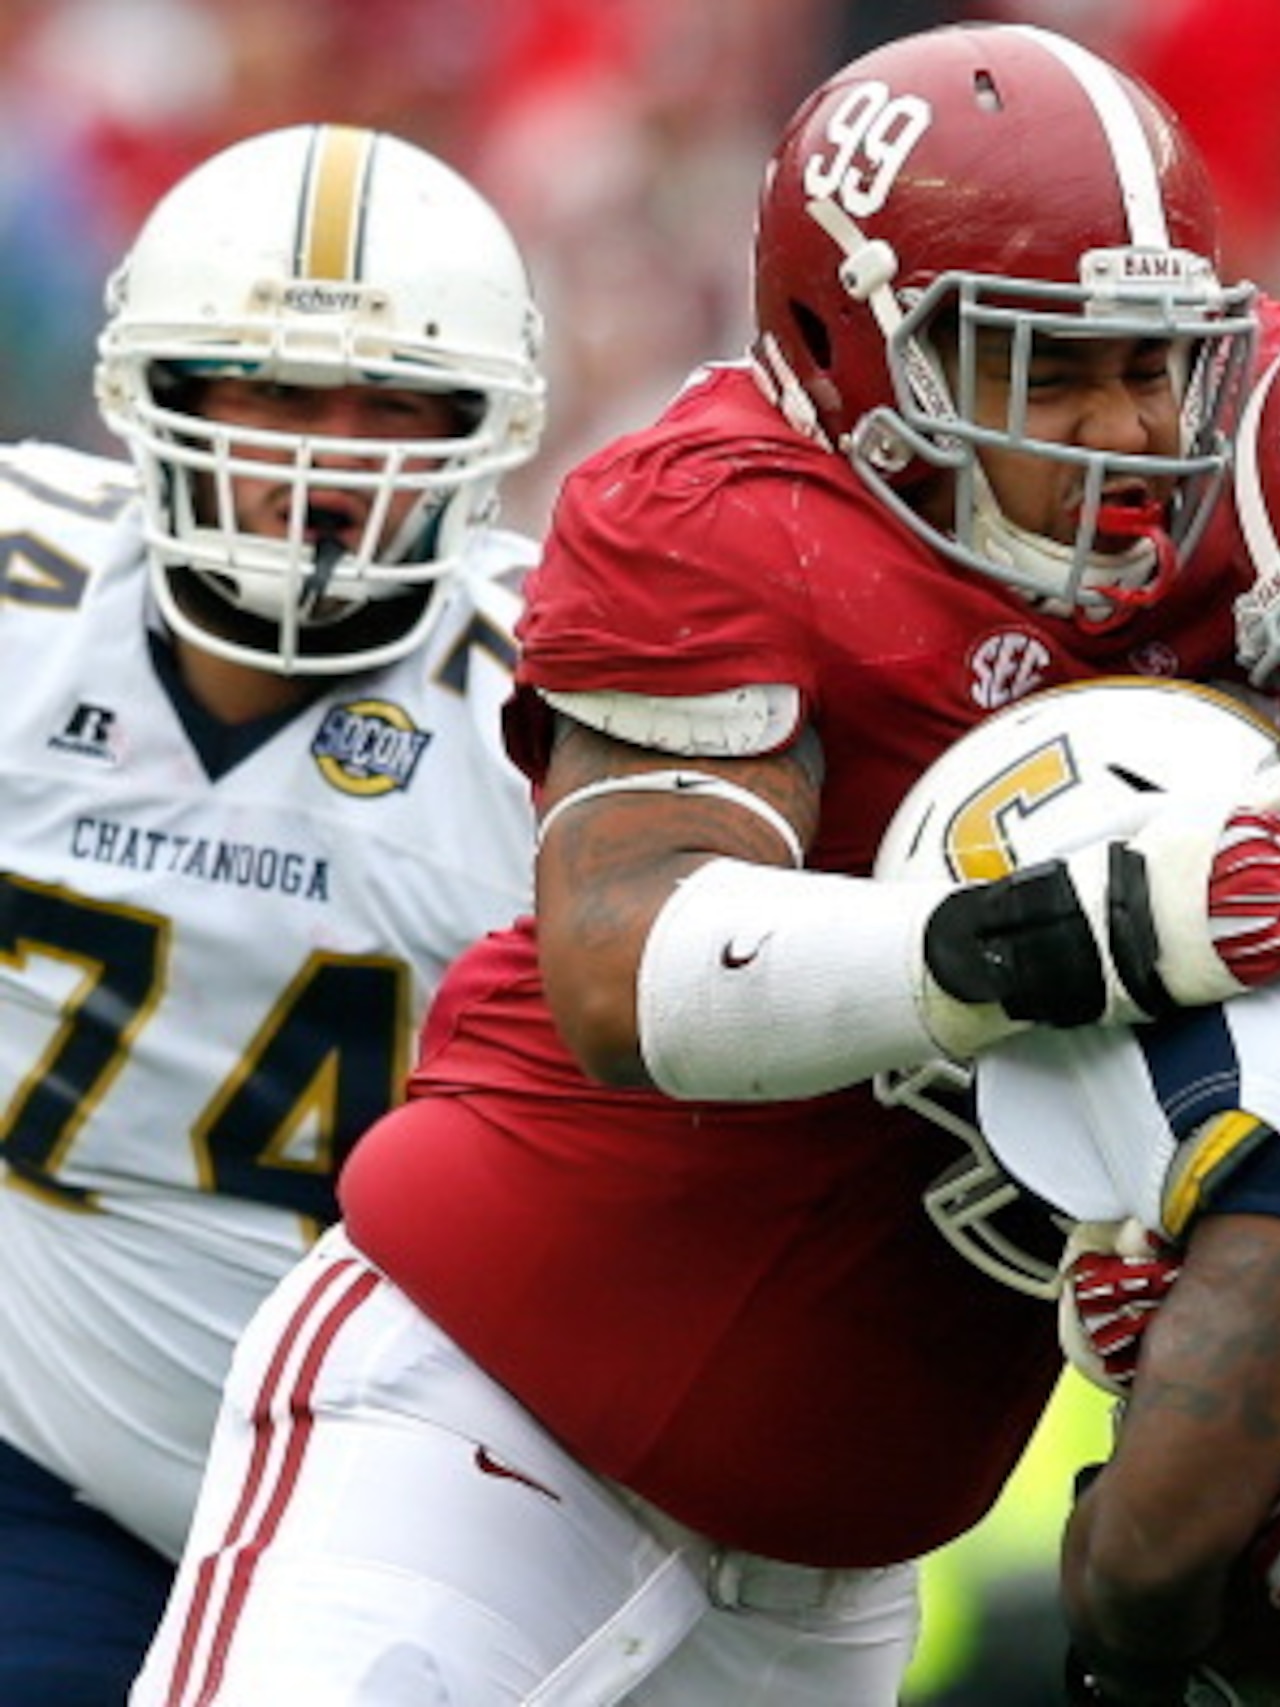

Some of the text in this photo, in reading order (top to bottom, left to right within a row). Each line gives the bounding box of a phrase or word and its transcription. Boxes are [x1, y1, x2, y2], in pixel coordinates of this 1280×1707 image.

[804, 80, 932, 218] 99
[1124, 257, 1182, 276] BAMA
[971, 632, 1050, 709] SEC
[316, 708, 424, 786] SOCON
[70, 818, 329, 902] CHATTANOOGA
[0, 868, 412, 1250] 74
